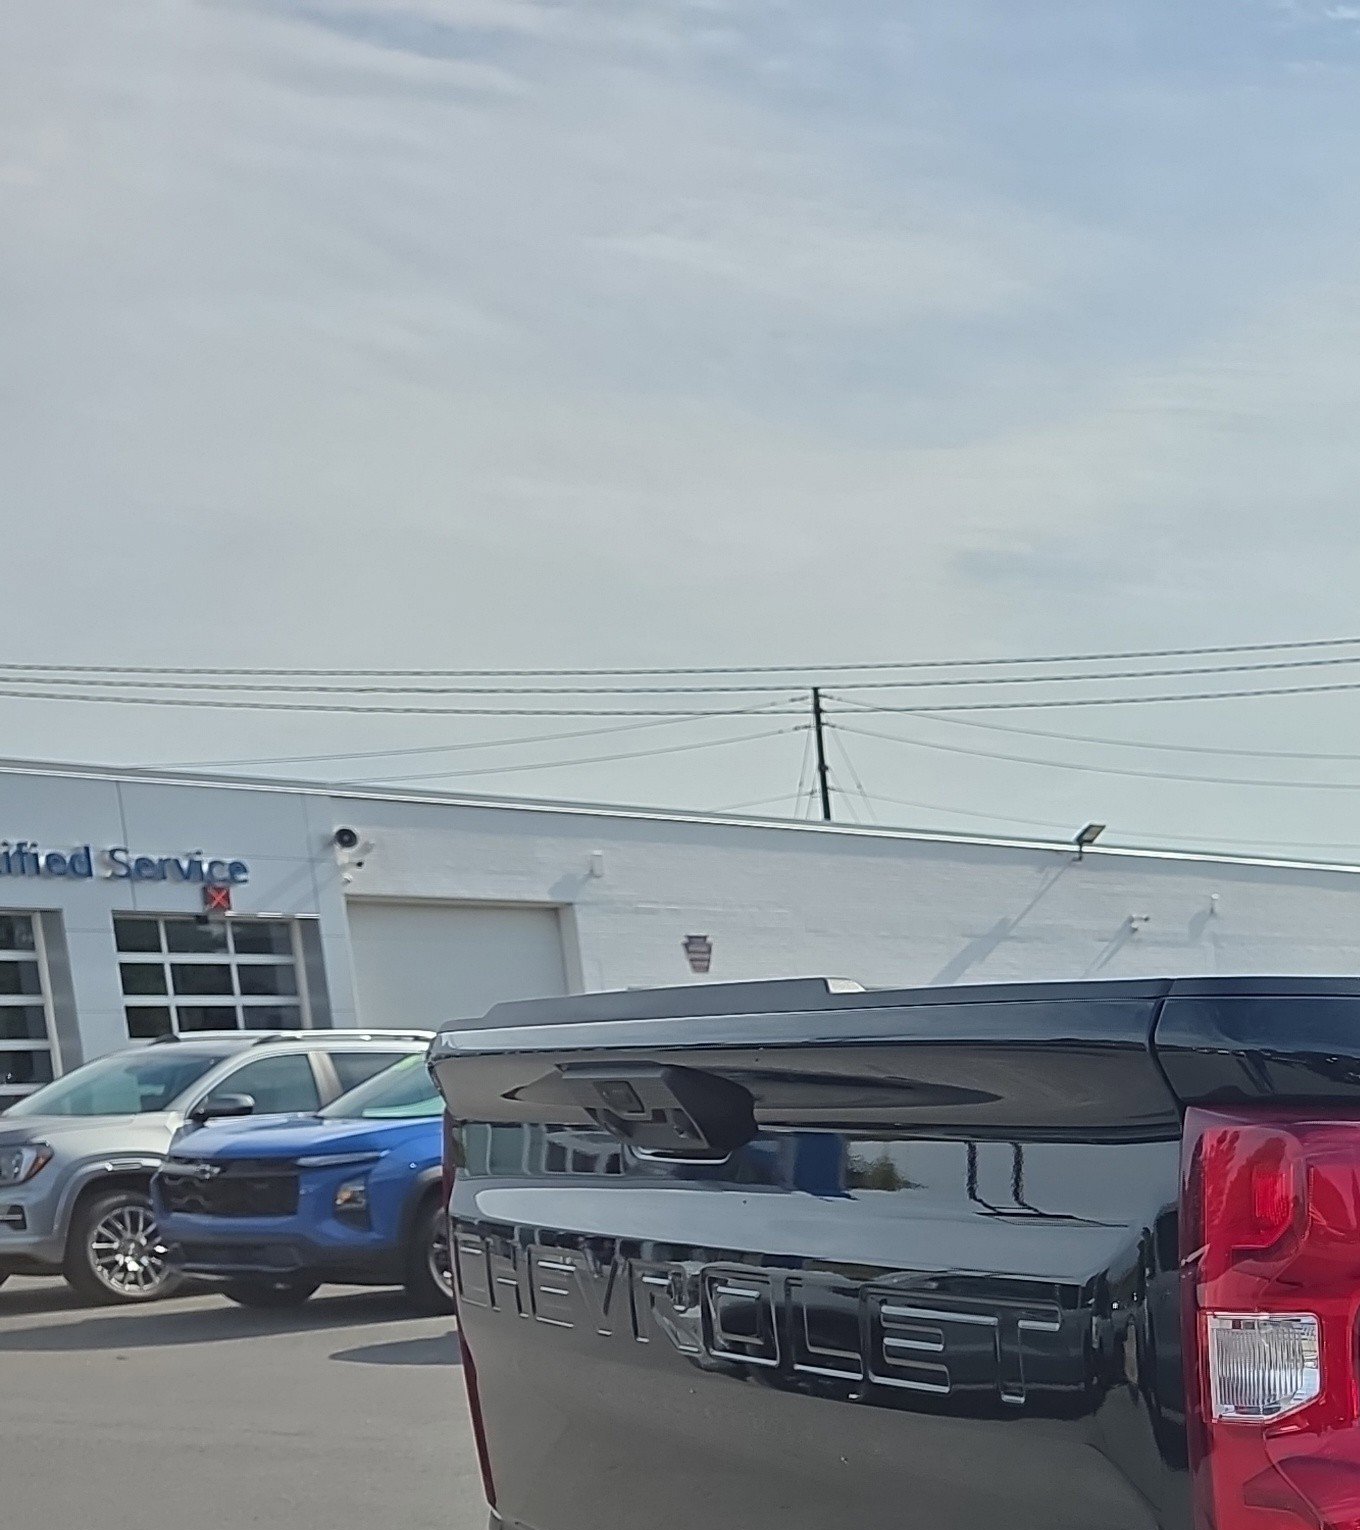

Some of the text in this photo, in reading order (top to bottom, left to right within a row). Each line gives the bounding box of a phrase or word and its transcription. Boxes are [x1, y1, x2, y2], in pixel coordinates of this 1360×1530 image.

[0, 840, 248, 884] ified Service
[452, 1226, 1063, 1406] CHEVROLET
